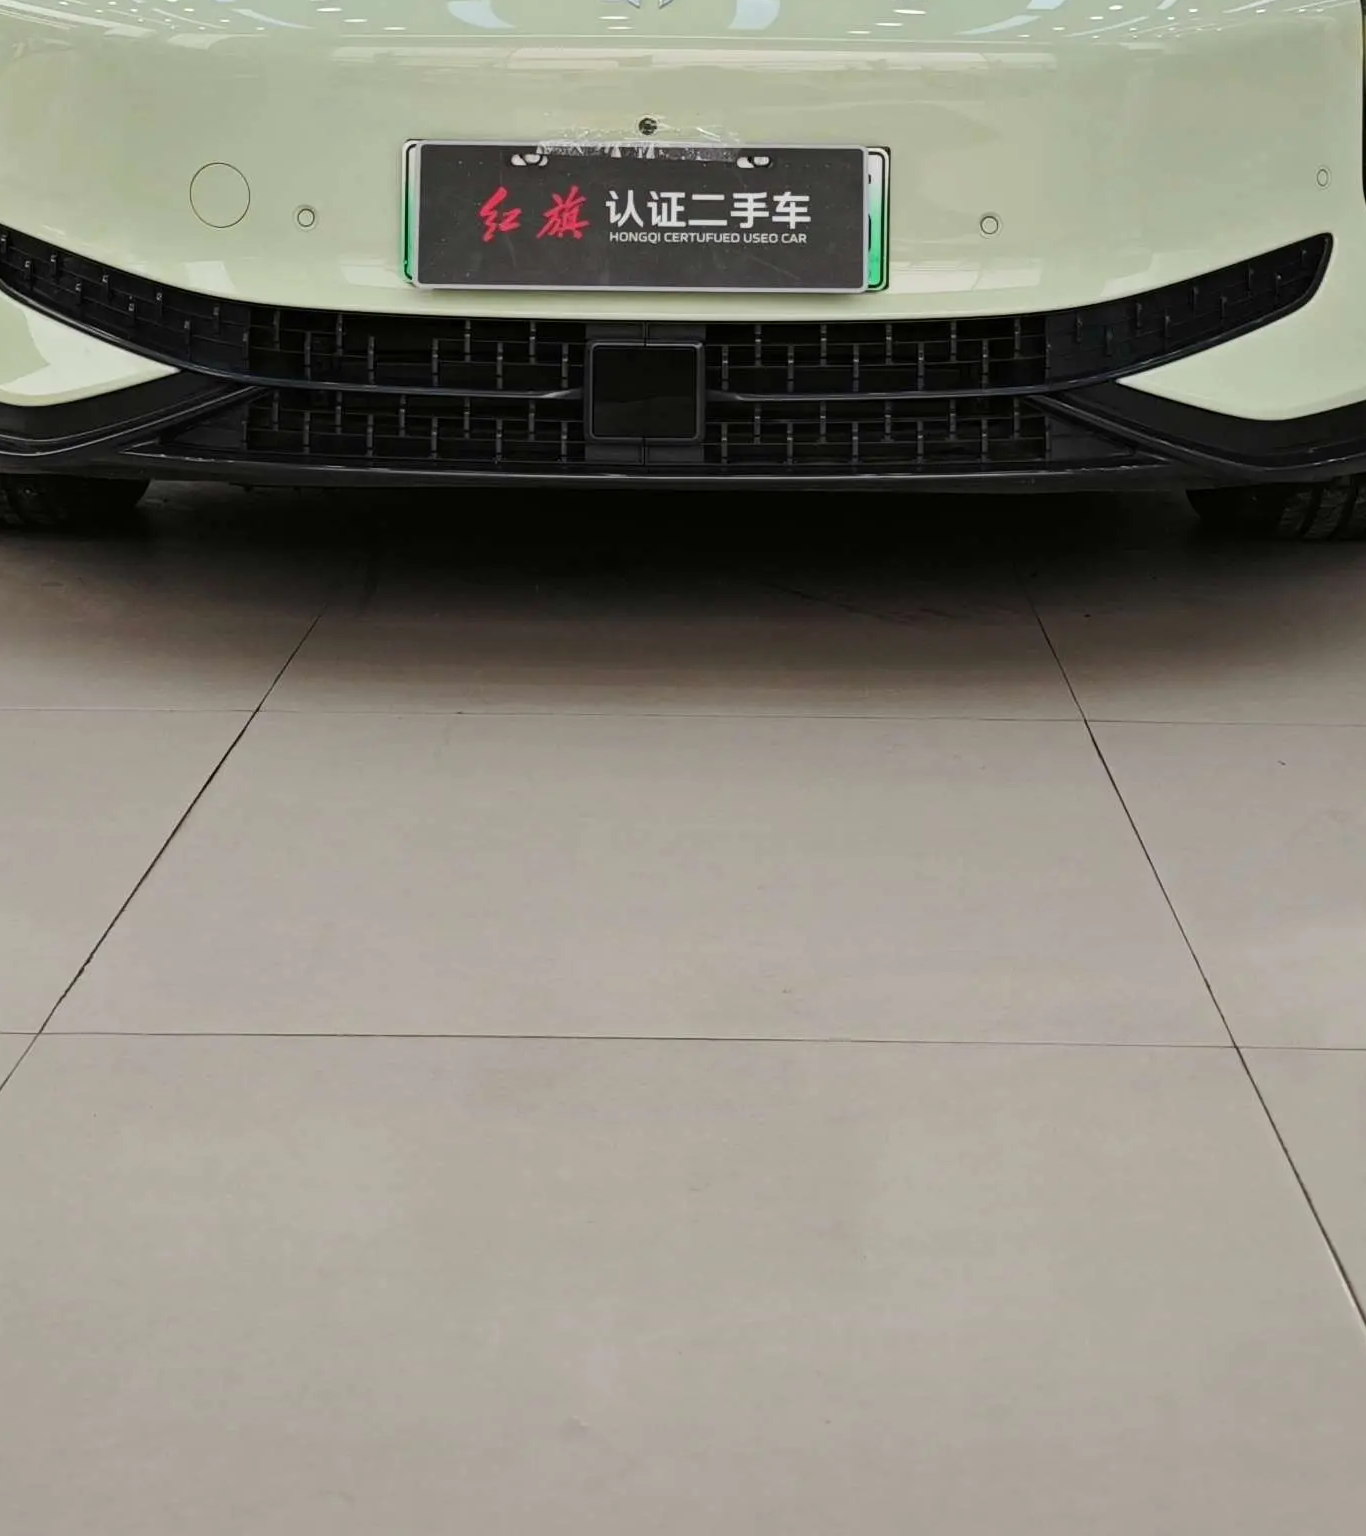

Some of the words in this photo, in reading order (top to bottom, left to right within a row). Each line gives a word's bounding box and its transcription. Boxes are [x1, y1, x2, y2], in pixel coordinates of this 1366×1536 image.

[477, 185, 590, 243] 红旗
[605, 190, 812, 230] 认证二手车
[609, 231, 661, 245] HONGQI
[781, 233, 807, 244] CAR
